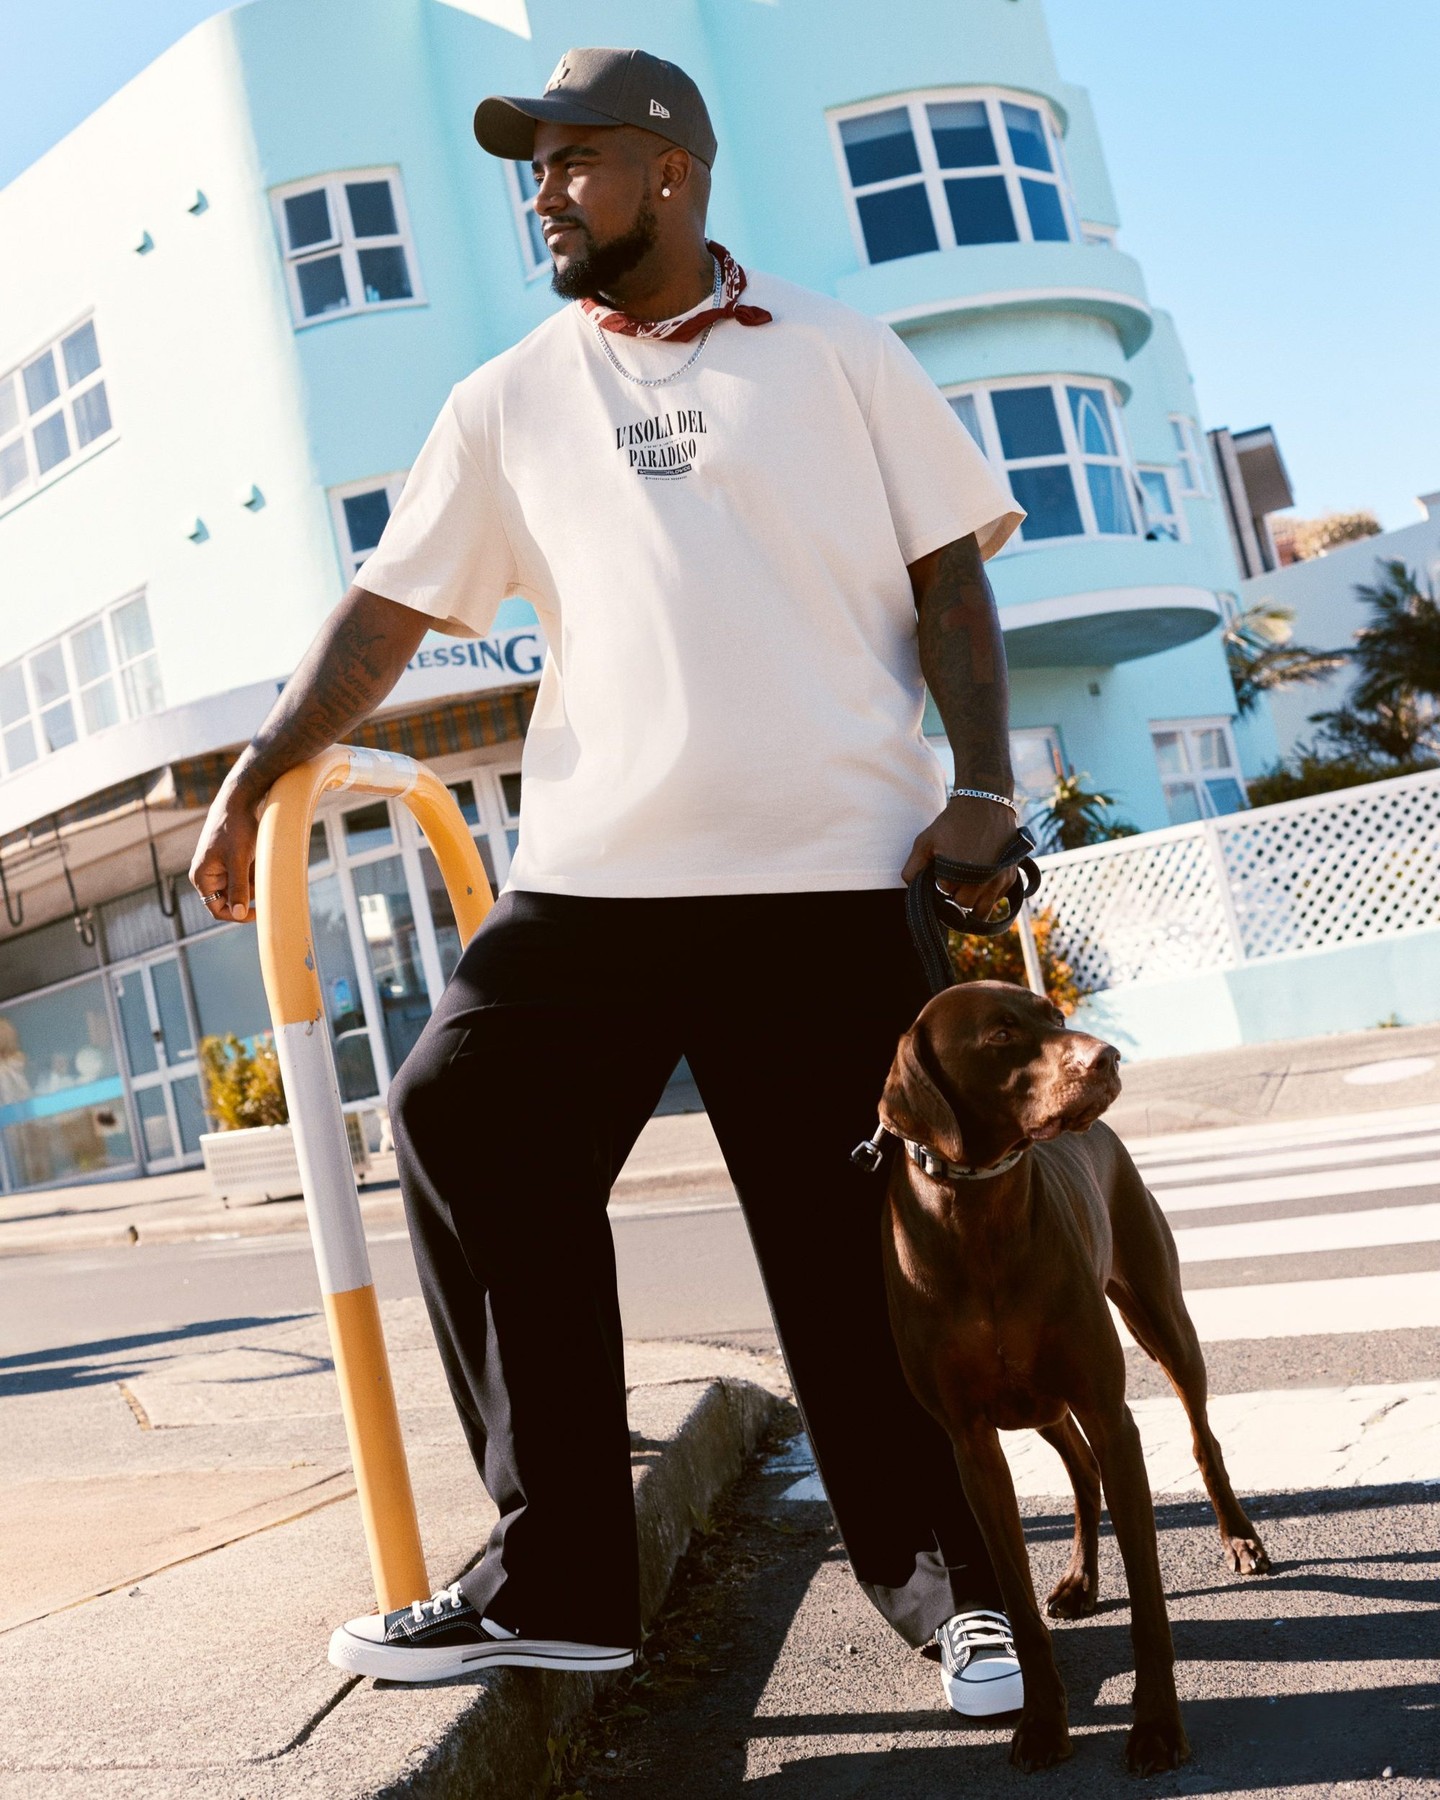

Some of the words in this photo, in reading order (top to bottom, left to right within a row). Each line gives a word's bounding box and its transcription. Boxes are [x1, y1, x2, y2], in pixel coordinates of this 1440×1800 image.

[616, 413, 674, 450] L'ISOLA
[677, 410, 707, 433] DEL
[629, 439, 697, 467] PARADISO
[406, 635, 542, 675] ESSING
